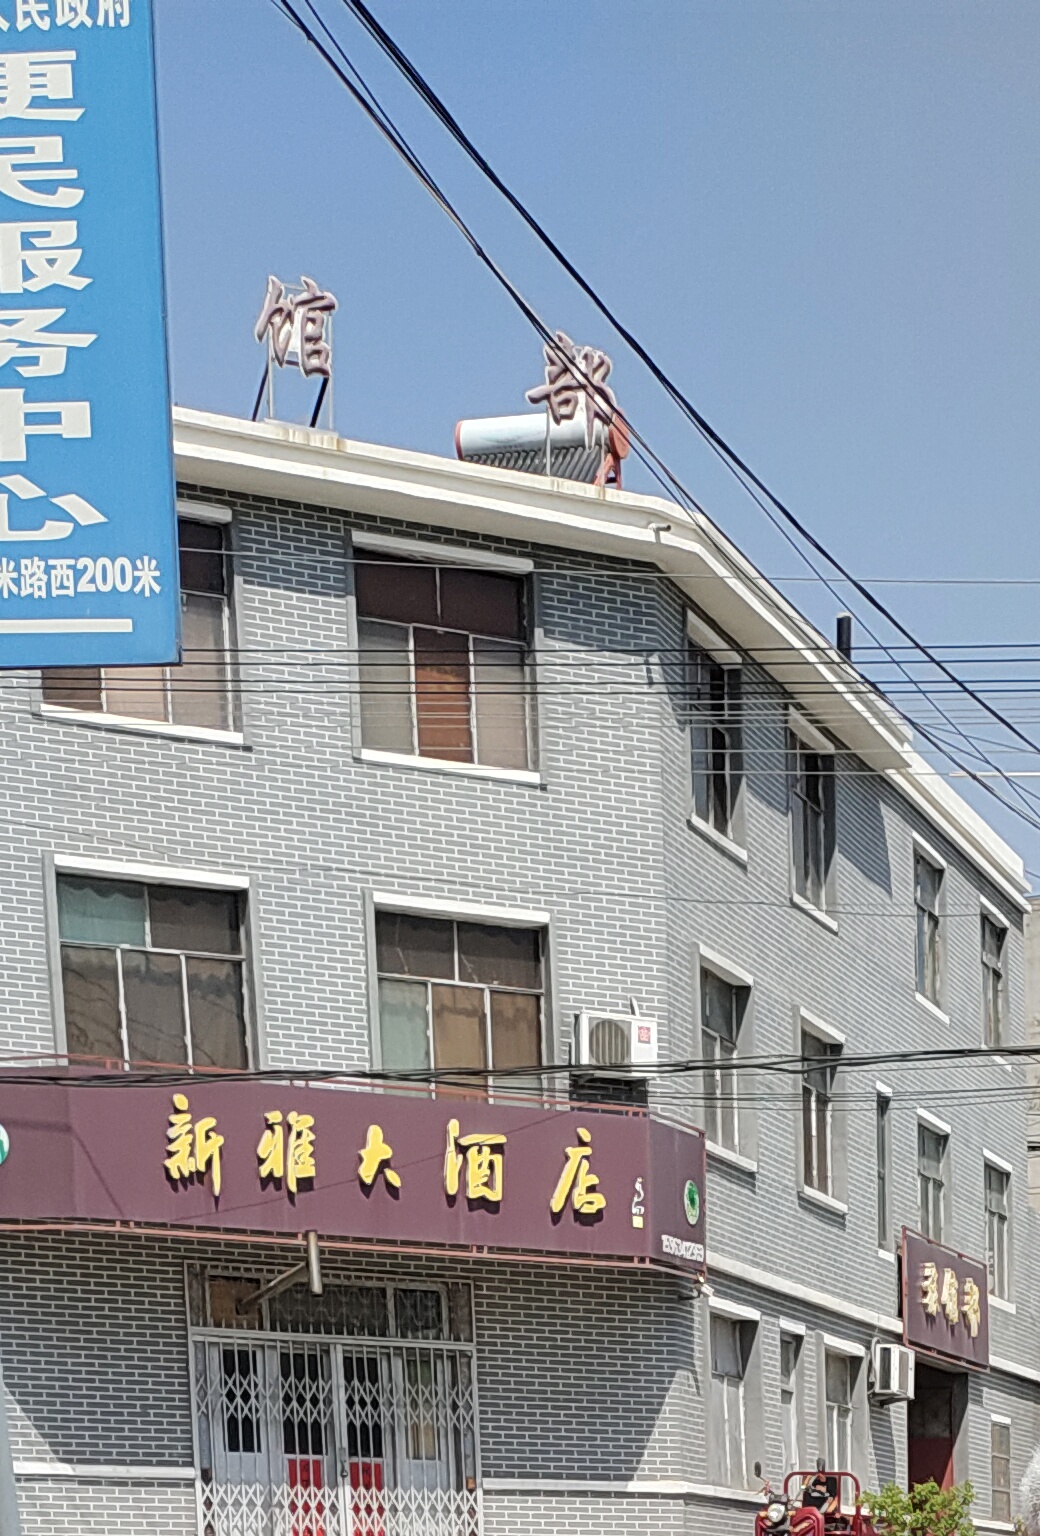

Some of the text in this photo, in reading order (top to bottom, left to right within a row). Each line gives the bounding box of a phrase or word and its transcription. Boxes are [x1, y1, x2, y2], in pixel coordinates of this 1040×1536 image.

[0, 0, 131, 32] 民政府
[163, 1093, 607, 1214] 新雅大酒店
